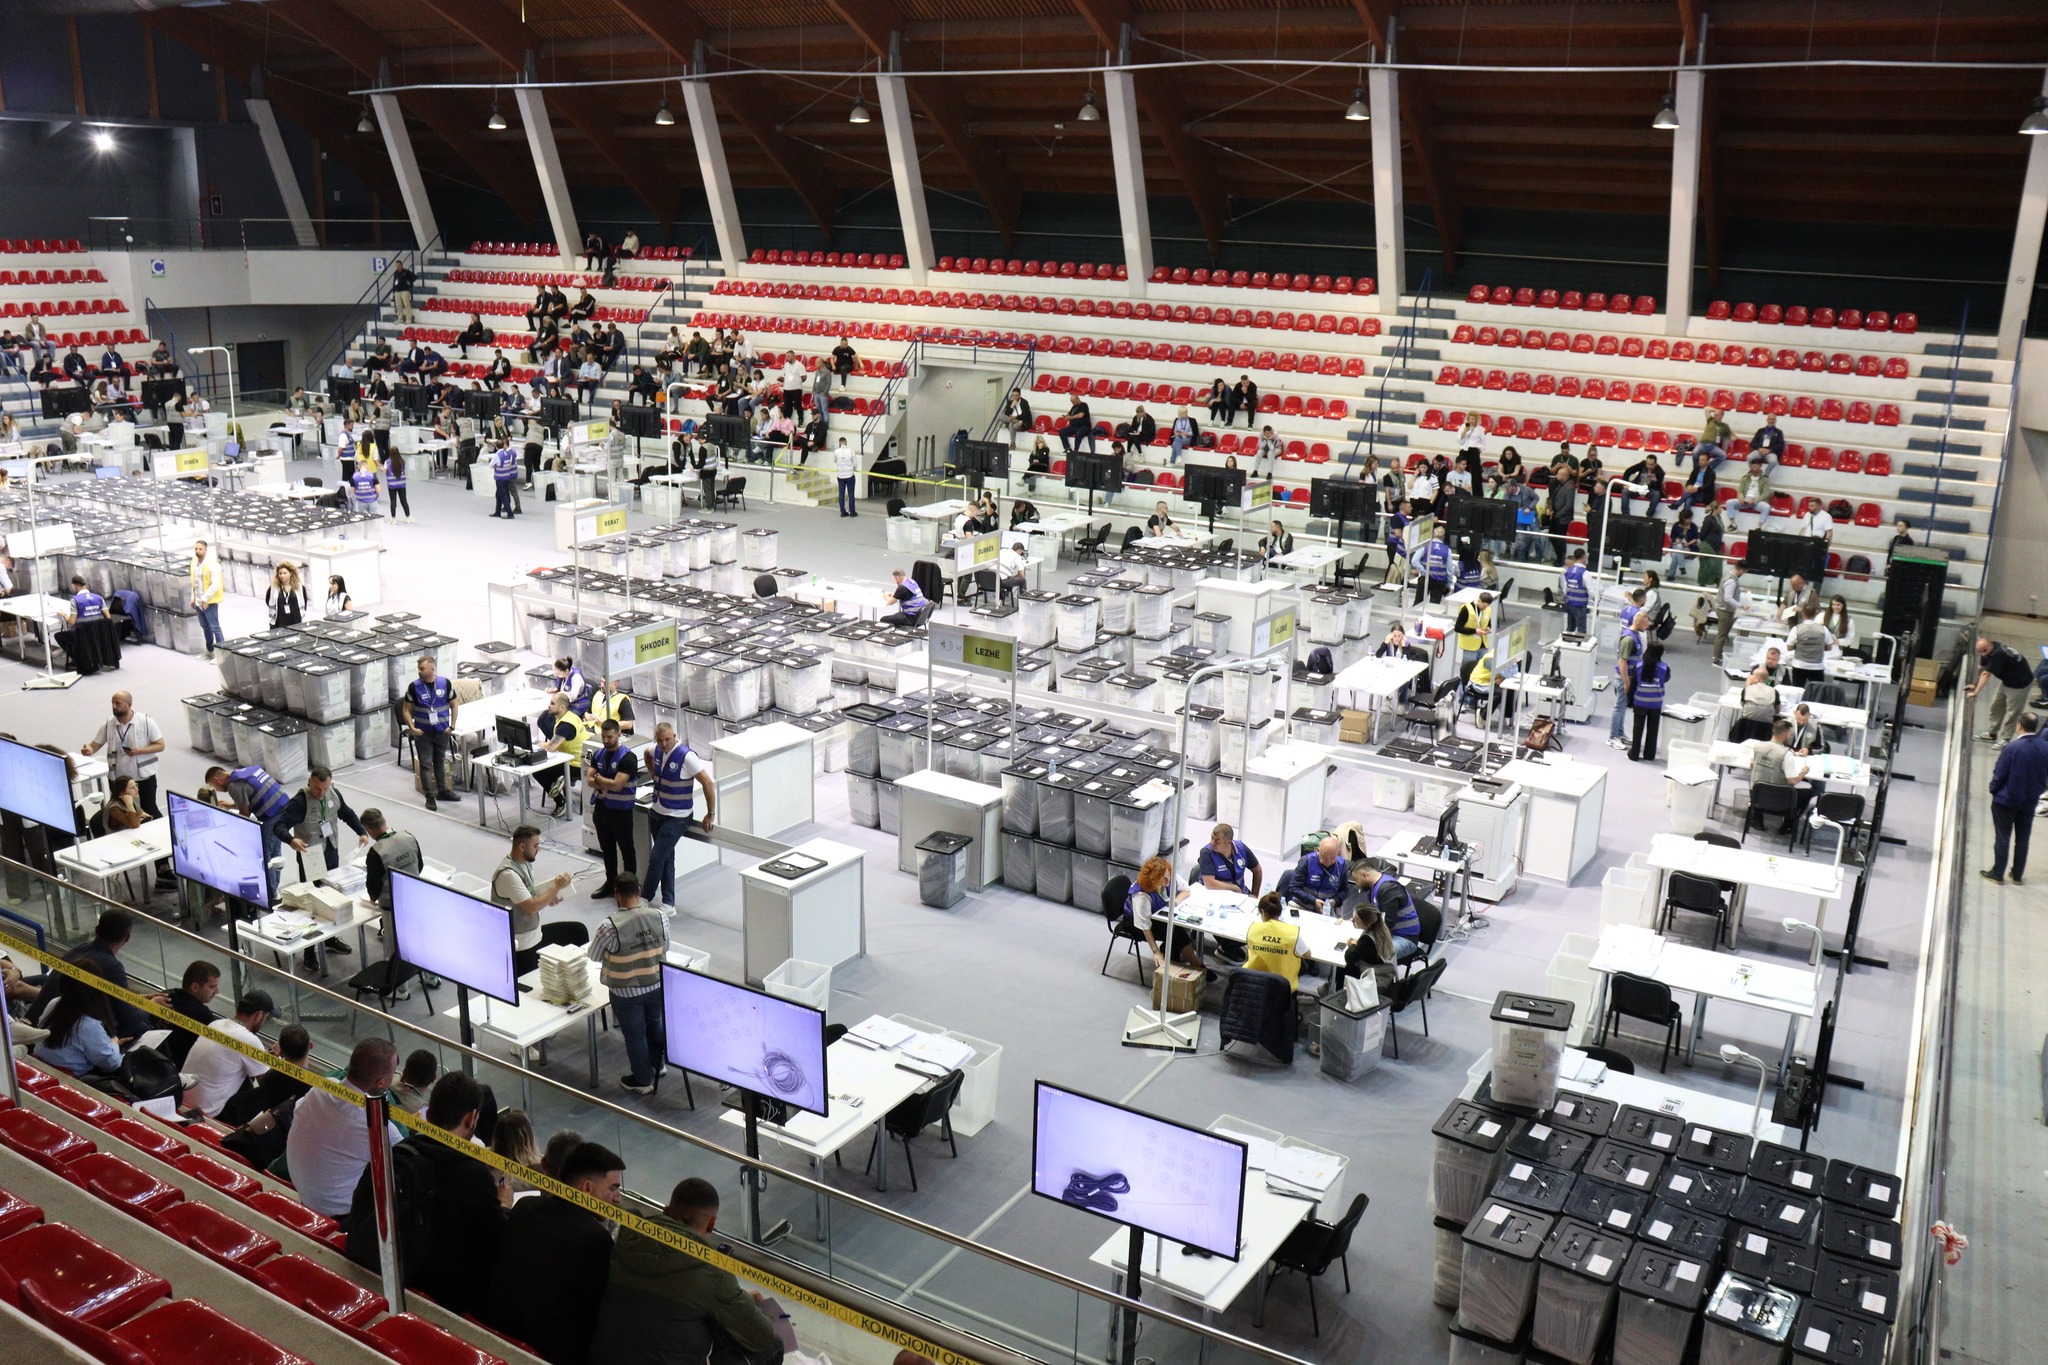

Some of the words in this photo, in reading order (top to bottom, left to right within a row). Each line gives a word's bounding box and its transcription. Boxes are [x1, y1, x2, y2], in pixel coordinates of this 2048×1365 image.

[151, 260, 164, 274] C
[604, 518, 619, 527] BERAT
[640, 636, 670, 653] SHKODËR
[975, 646, 1000, 660] LEZHË
[1262, 935, 1282, 944] KZAZ
[1252, 945, 1289, 956] KOMISIONER
[159, 1006, 201, 1033] KOMISIONI
[202, 1026, 243, 1051] QENDROR
[251, 1048, 305, 1080] ZGJEDHJEVE
[323, 1081, 366, 1107] www.kqz.g
[414, 1118, 481, 1156] www.kqz.gov.al
[504, 1159, 562, 1195] KOMISIONI
[565, 1186, 623, 1223] QENDROR
[634, 1216, 711, 1262] ZGJEDHJEVE
[741, 1263, 829, 1311] www.kqz.gov.al
[861, 1317, 940, 1360] KOMISIONI
